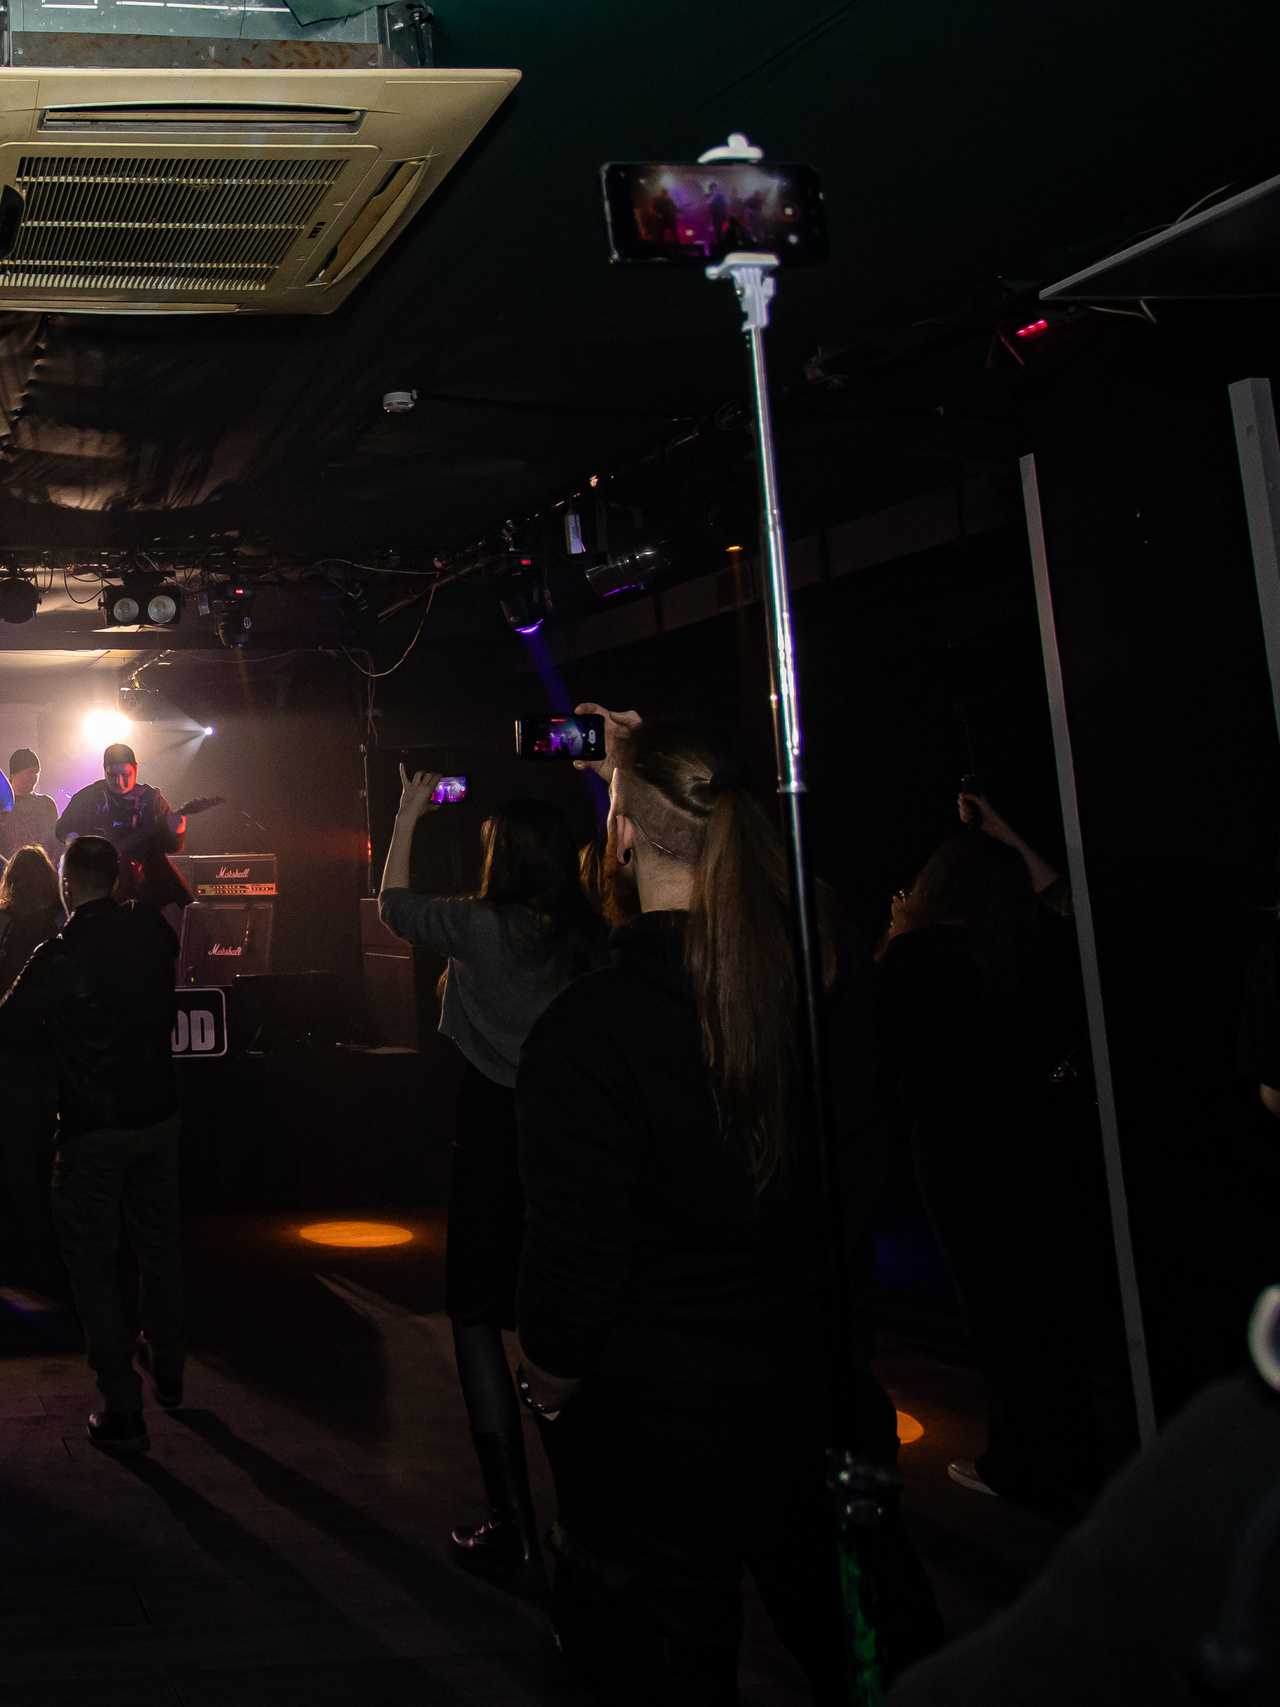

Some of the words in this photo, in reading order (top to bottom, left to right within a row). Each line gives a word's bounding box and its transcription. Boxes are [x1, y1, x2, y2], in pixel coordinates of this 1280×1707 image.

[215, 866, 251, 879] Marshall
[208, 943, 242, 956] Marshall
[170, 1009, 216, 1053] OD
